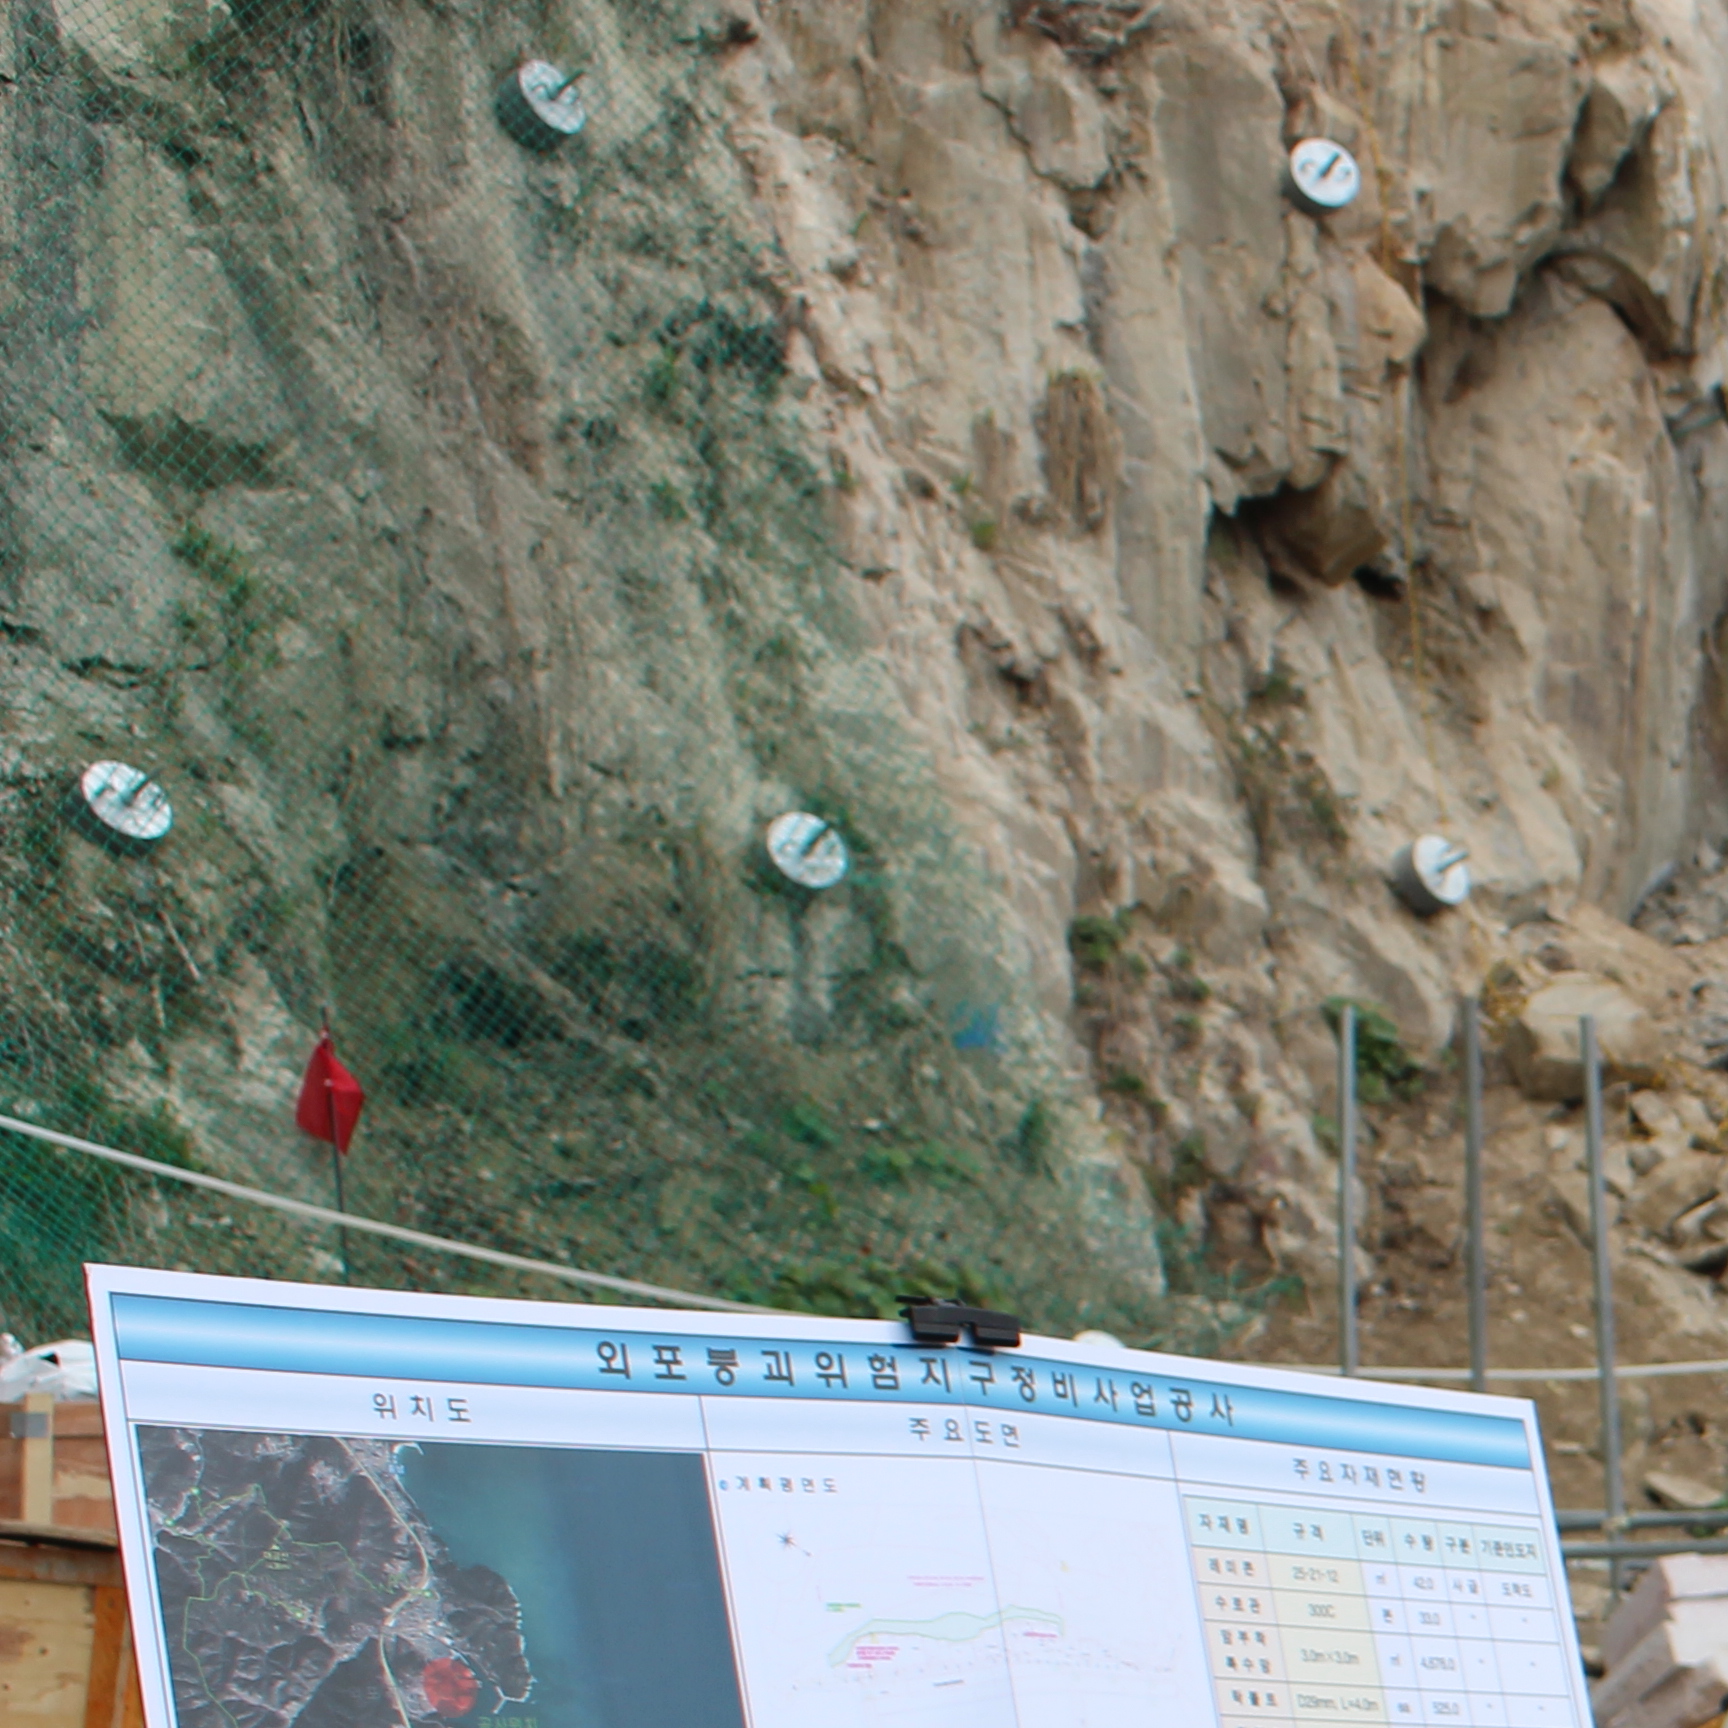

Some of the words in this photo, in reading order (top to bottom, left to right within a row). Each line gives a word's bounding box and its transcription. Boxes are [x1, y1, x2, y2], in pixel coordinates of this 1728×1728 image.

[372, 1392, 471, 1423] 위치도
[908, 1417, 1020, 1449] 주요도면
[1292, 1457, 1426, 1494] 주요자재현황
